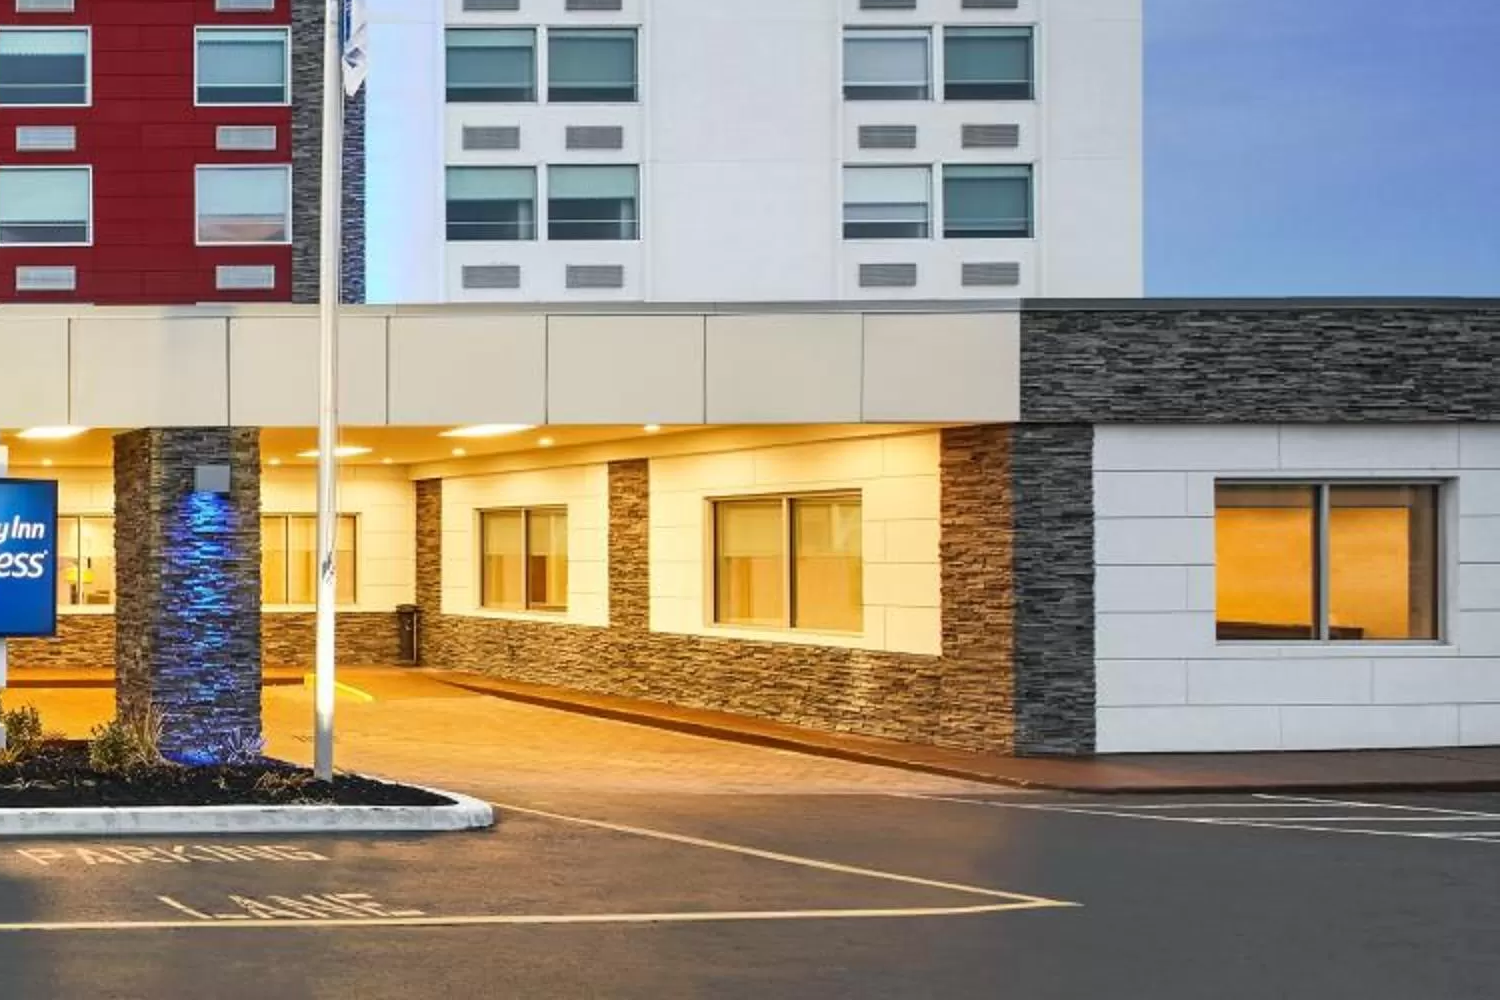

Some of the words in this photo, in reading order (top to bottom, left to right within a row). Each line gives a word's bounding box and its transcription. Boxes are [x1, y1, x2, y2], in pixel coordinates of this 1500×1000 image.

[11, 514, 45, 539] Inn
[16, 845, 330, 865] PARKING
[155, 893, 427, 919] LANE
